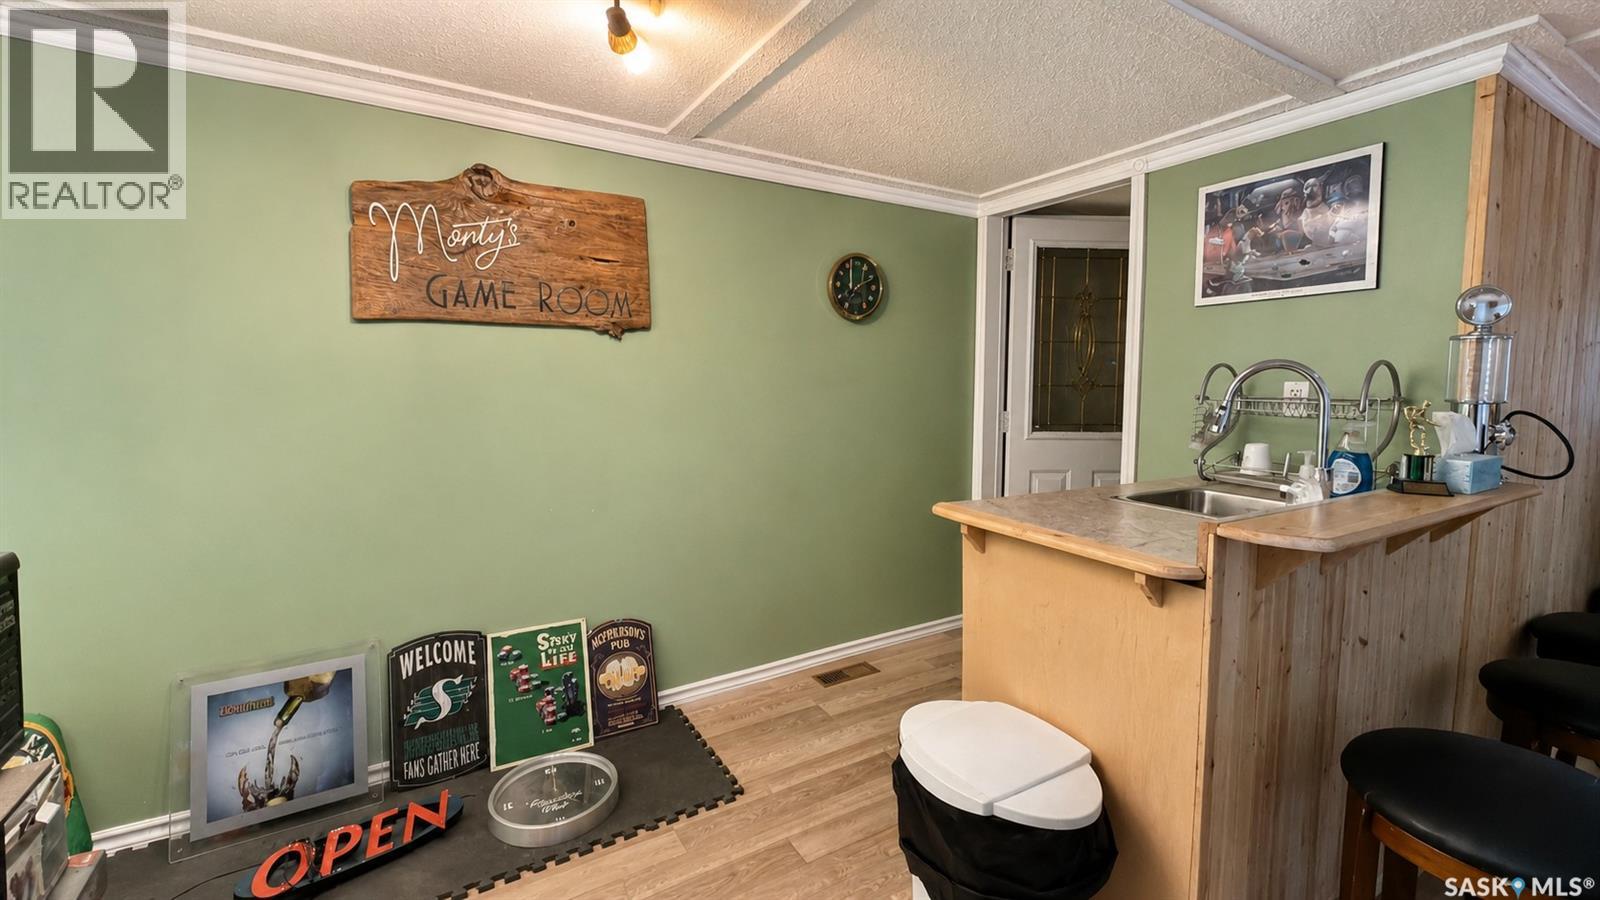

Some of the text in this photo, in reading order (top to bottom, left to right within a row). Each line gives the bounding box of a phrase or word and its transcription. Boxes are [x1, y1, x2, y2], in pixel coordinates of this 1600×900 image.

[368, 201, 521, 282] Monty's
[425, 274, 634, 319] GAME ROOM
[399, 639, 477, 680] WELCOME
[541, 651, 577, 668] LIFE
[610, 639, 630, 650] PUB
[403, 741, 480, 780] FANS GATHER HERE
[251, 788, 448, 899] OPEN
